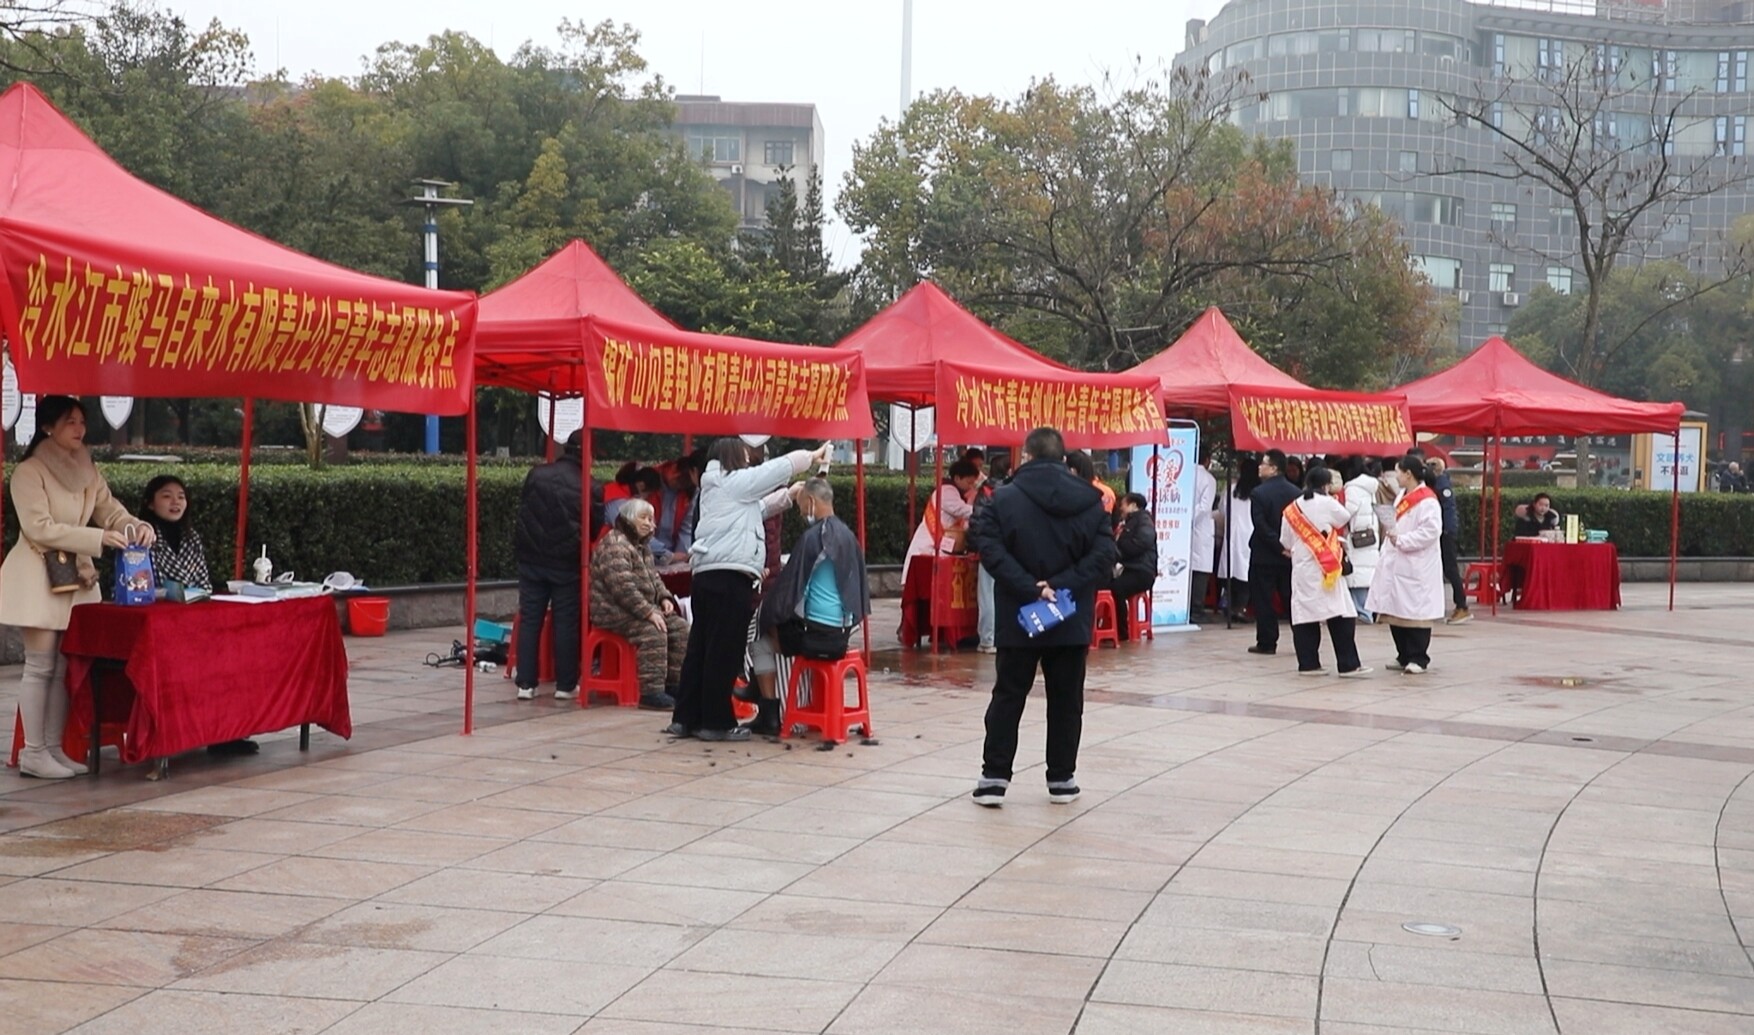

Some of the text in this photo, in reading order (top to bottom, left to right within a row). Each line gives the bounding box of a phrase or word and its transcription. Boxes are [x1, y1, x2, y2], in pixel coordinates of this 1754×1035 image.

[19, 253, 457, 389] 冷水江市骏马自来水有限责任公司青年志愿服务点
[602, 336, 852, 421] 锡矿山闪星锑业有限责任公司青年志愿服务点
[956, 375, 1165, 434] 冷水江市青年创业协会青年志愿服务点
